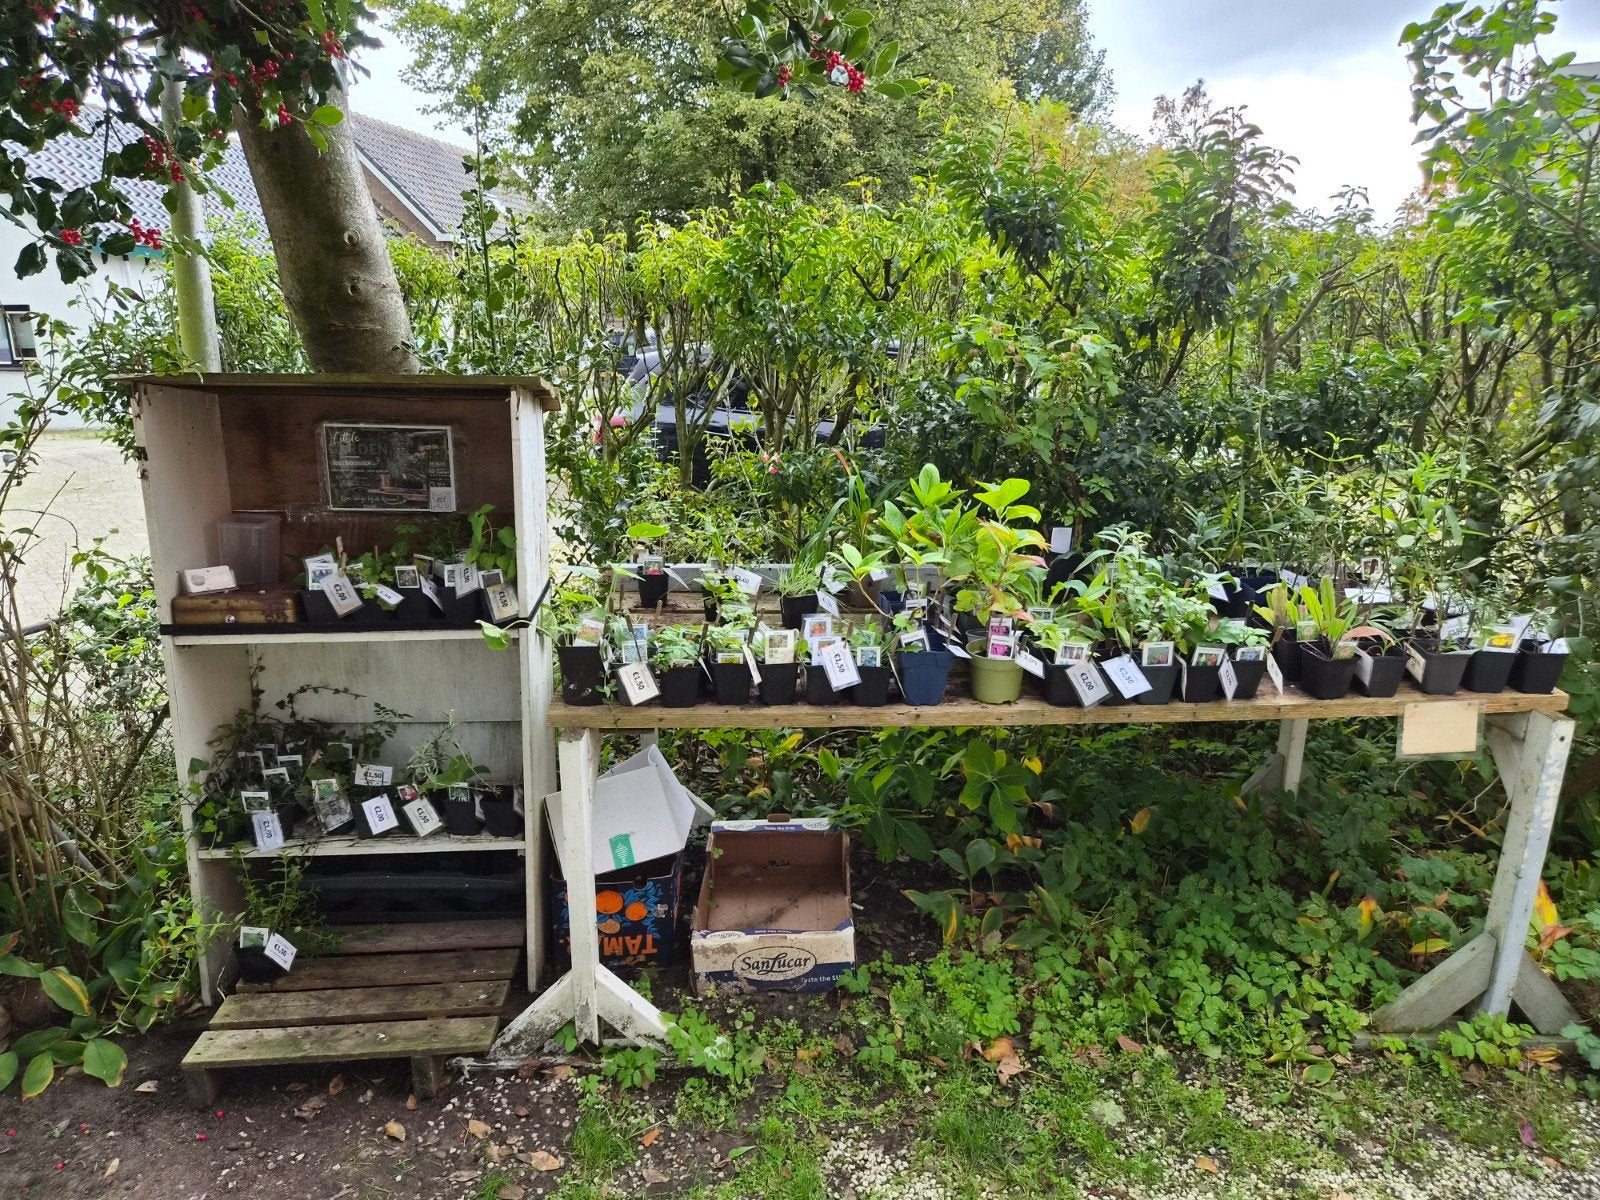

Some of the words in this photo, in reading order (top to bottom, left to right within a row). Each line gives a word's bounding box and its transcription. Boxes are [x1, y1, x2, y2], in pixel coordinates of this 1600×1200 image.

[333, 583, 347, 601] €2,00
[498, 591, 508, 608] €1,50
[833, 653, 845, 673] €1,50
[632, 671, 645, 691] €1,50
[1080, 672, 1094, 691] €2,00
[1119, 667, 1135, 685] €2,50
[374, 805, 385, 822] €2,00
[416, 807, 430, 824] €1,50
[740, 952, 811, 975] SanLucar
